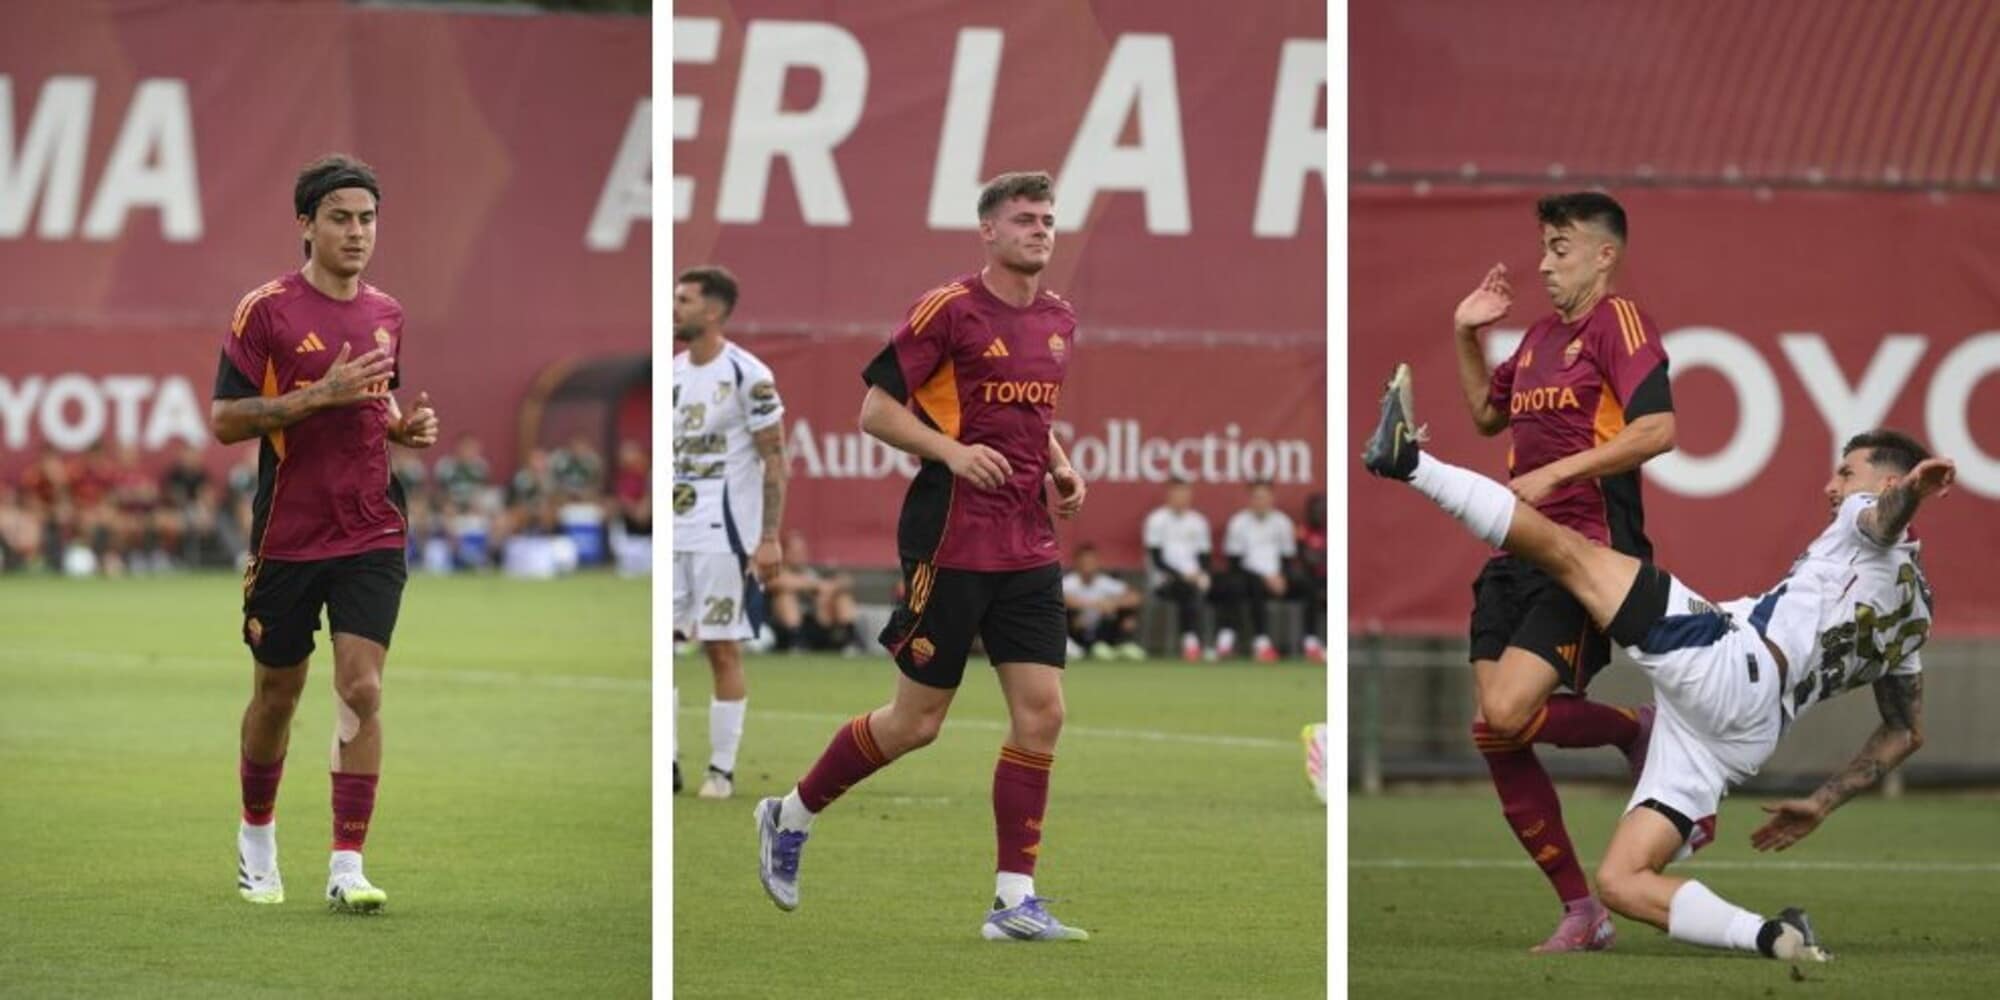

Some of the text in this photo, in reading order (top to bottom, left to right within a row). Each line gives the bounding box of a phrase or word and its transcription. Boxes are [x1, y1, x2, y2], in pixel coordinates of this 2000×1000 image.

[0, 72, 204, 241] MA
[927, 26, 1192, 236] LA
[0, 371, 208, 451] YOTA
[1485, 327, 2000, 499] OYO
